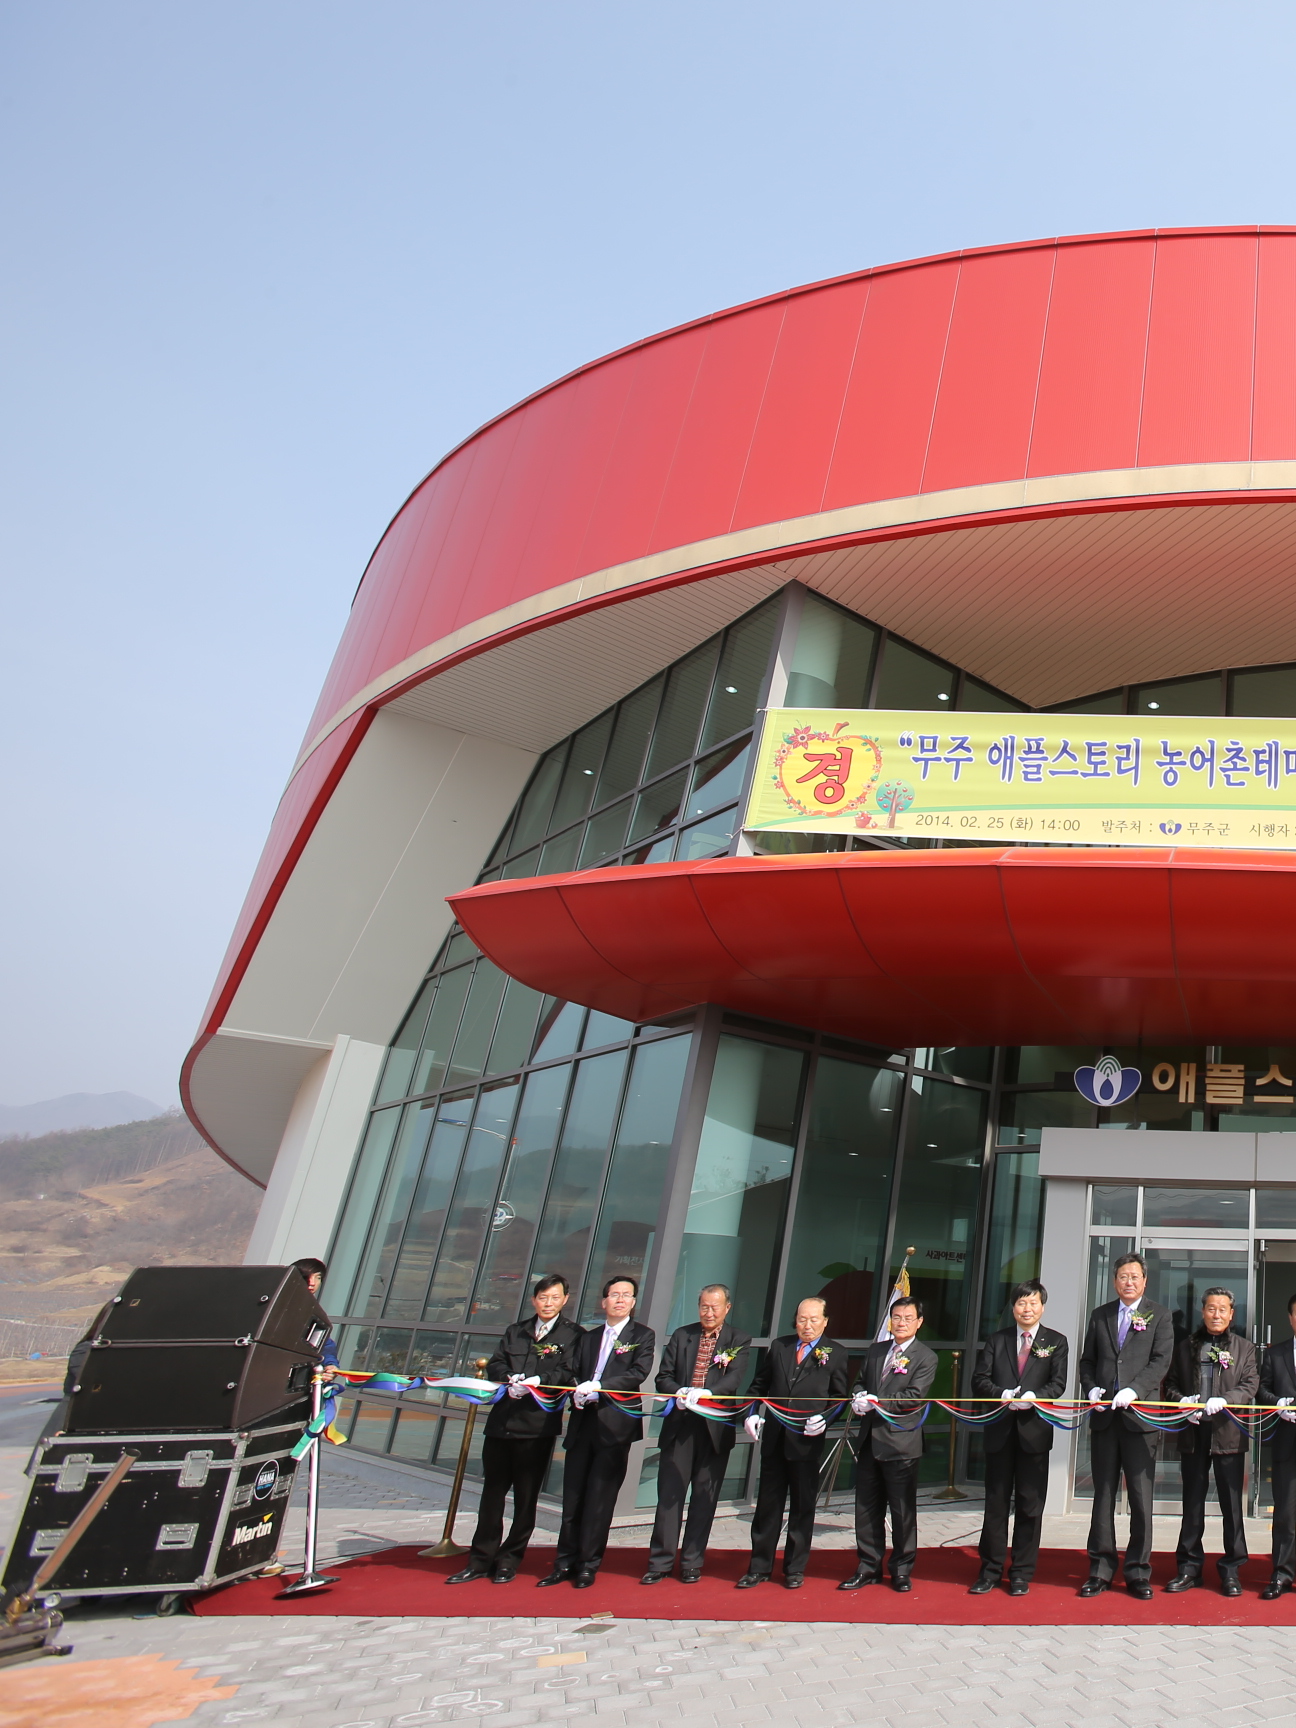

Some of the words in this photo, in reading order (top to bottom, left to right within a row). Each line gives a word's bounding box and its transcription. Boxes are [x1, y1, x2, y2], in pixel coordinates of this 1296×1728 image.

[986, 734, 1142, 787] 애플스토리
[796, 747, 853, 804] 경
[915, 814, 955, 828] 2014.
[960, 816, 982, 829] 02.
[987, 817, 1005, 829] 25
[1009, 817, 1034, 831] (화)
[1040, 819, 1081, 832] 14:00
[1101, 820, 1142, 834] 발주처
[1186, 822, 1231, 836] 무주군
[259, 1472, 275, 1485] HANA
[232, 1521, 273, 1546] Martin
